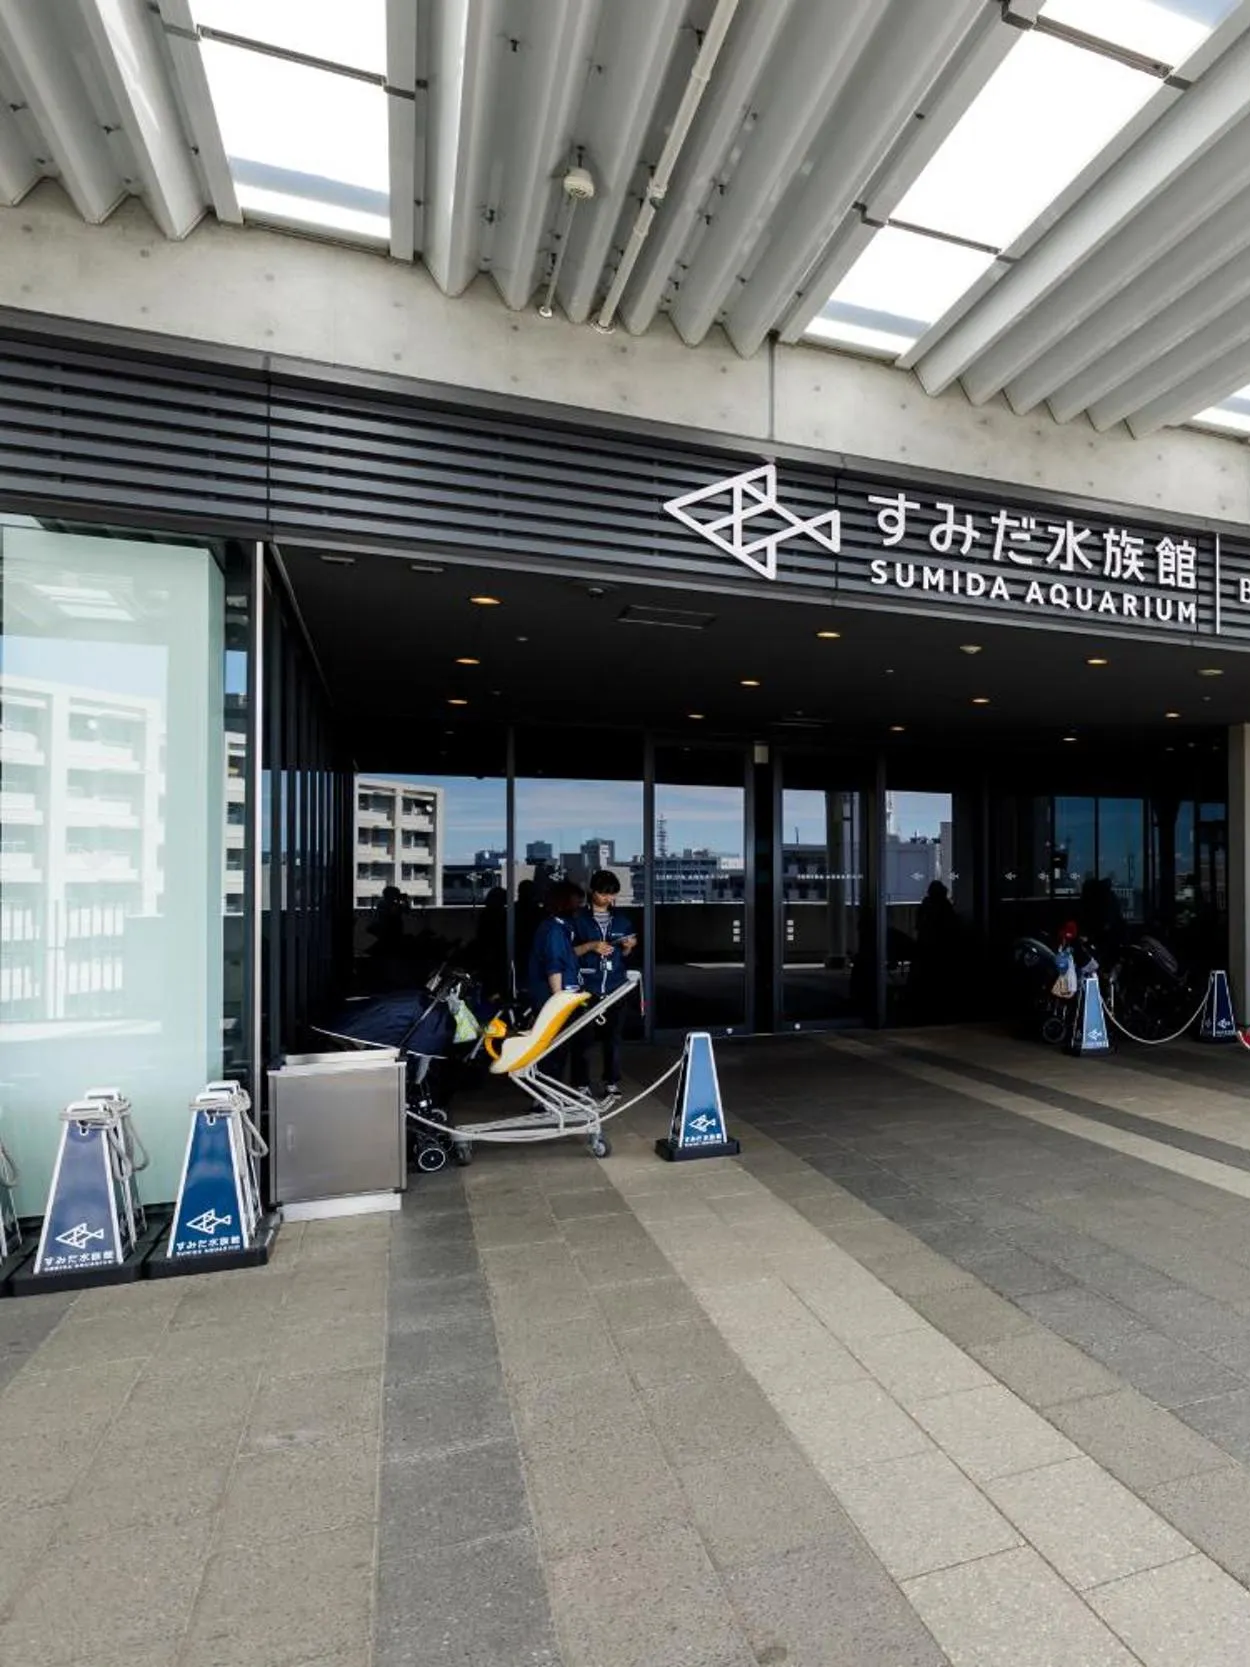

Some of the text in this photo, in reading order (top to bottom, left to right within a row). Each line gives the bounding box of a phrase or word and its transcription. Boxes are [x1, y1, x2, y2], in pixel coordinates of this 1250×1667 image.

[868, 493, 1197, 589] すみだ水族館
[871, 560, 1196, 624] SUMIDA AQUARIUM
